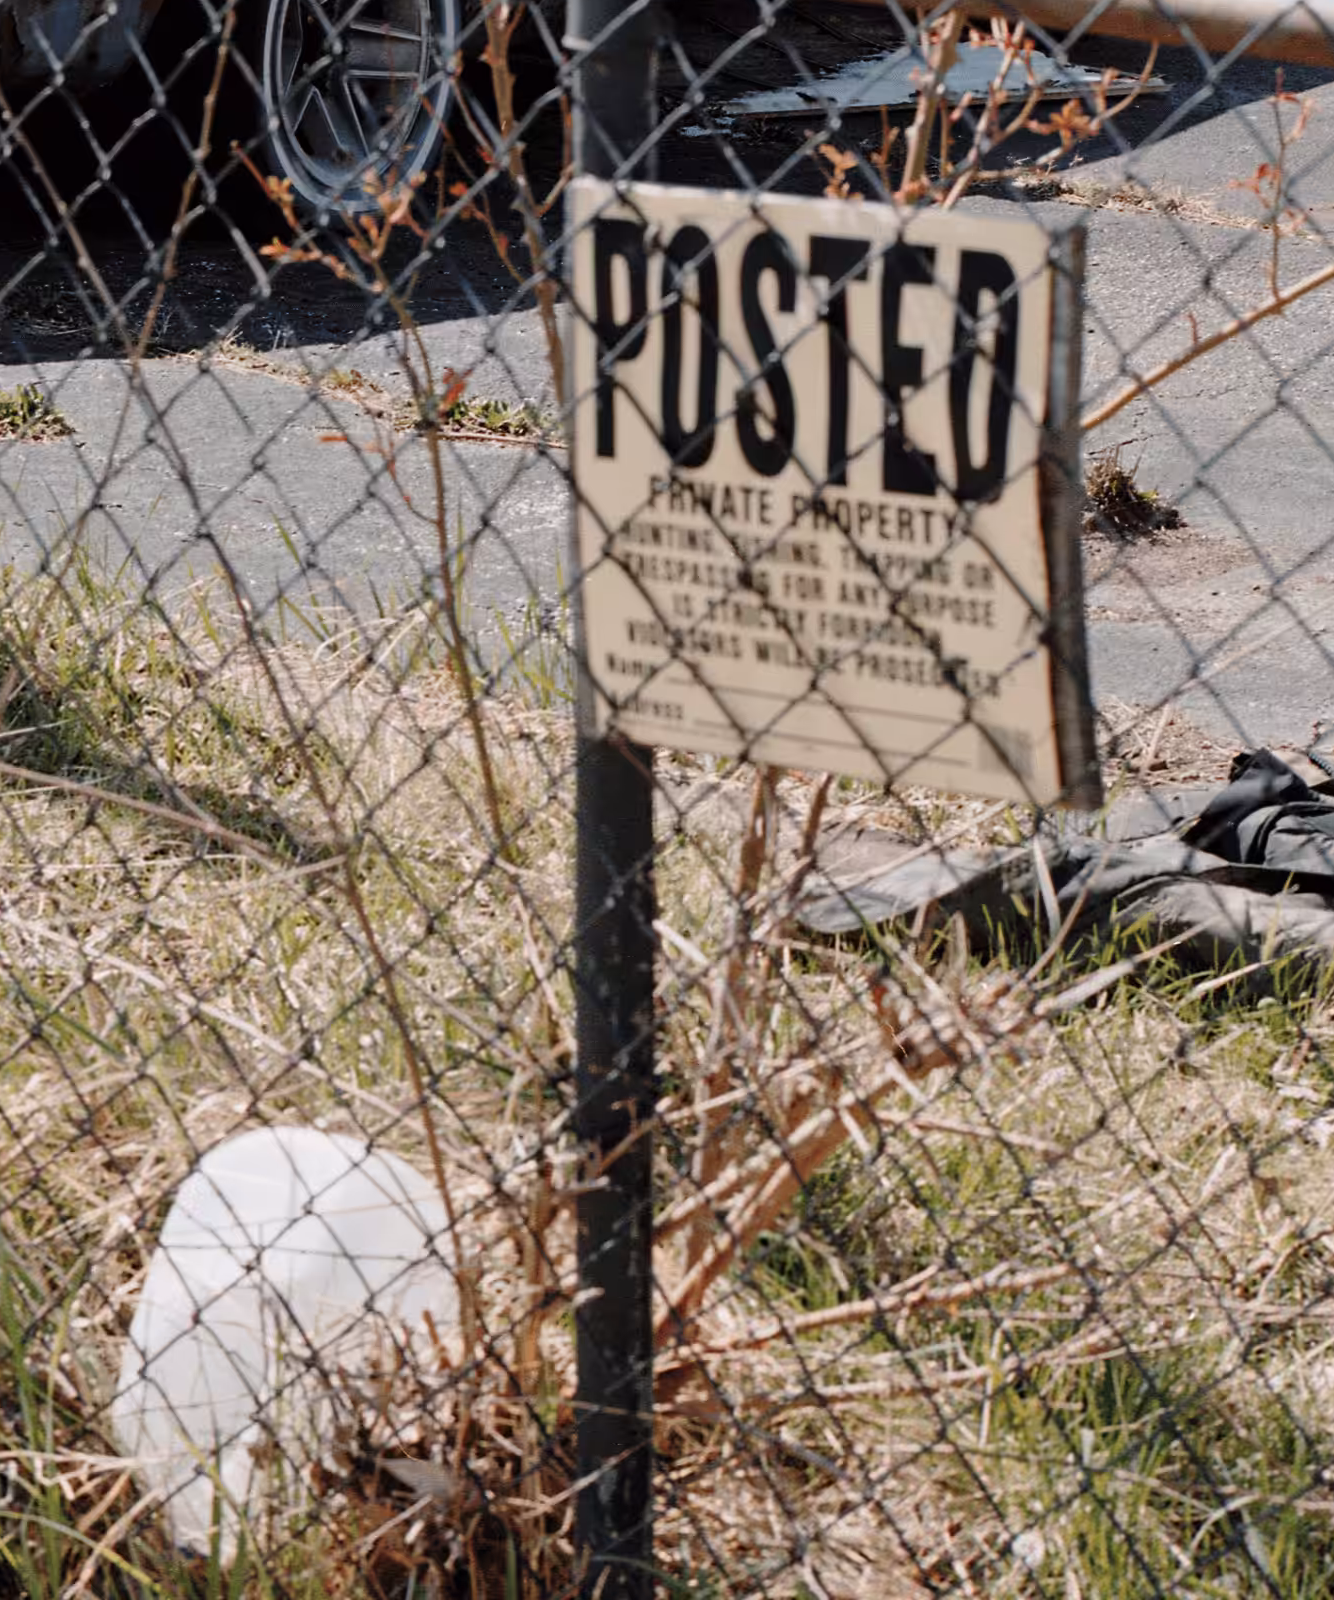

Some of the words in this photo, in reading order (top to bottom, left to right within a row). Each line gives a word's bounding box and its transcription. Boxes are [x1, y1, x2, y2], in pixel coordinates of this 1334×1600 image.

[595, 218, 1019, 503] POSTED
[649, 475, 771, 525] PRIVATE
[792, 495, 958, 544] PROPERTY
[628, 554, 768, 598] TRESPASSG
[783, 574, 826, 602] FOR
[839, 581, 880, 610] ANY
[892, 589, 997, 628] URPOSE
[840, 546, 950, 584] TRPPING
[627, 620, 741, 660] VIOTORS
[856, 650, 1000, 698] PROSECED
[708, 597, 806, 634] STRICY
[818, 612, 941, 652] FORBDD
